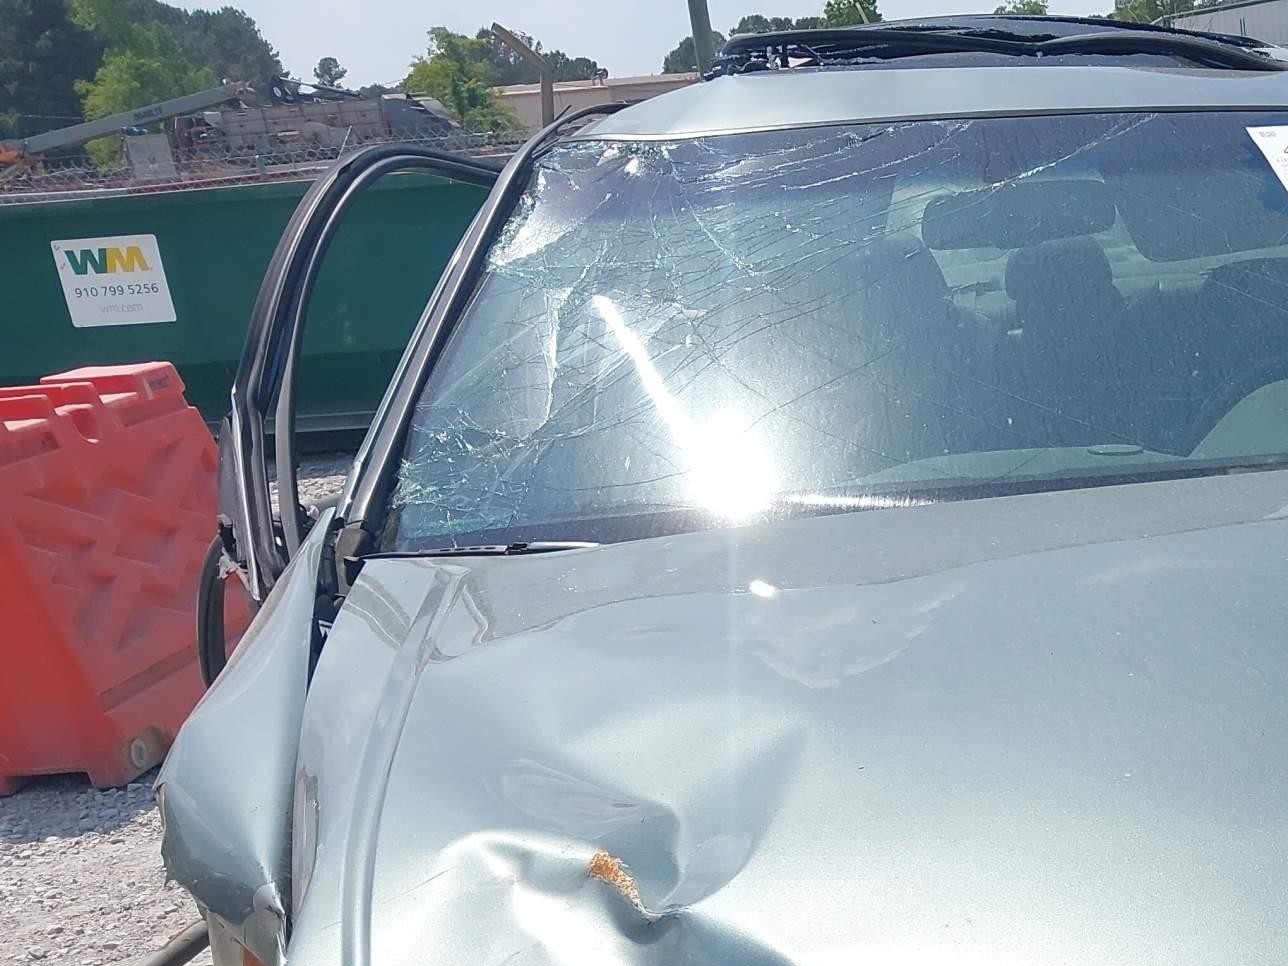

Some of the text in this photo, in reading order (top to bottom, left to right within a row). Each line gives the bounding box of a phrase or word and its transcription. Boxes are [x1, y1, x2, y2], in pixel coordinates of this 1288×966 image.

[64, 245, 149, 275] WM
[74, 282, 159, 298] 910 799 5256
[100, 303, 144, 313] wm.com
